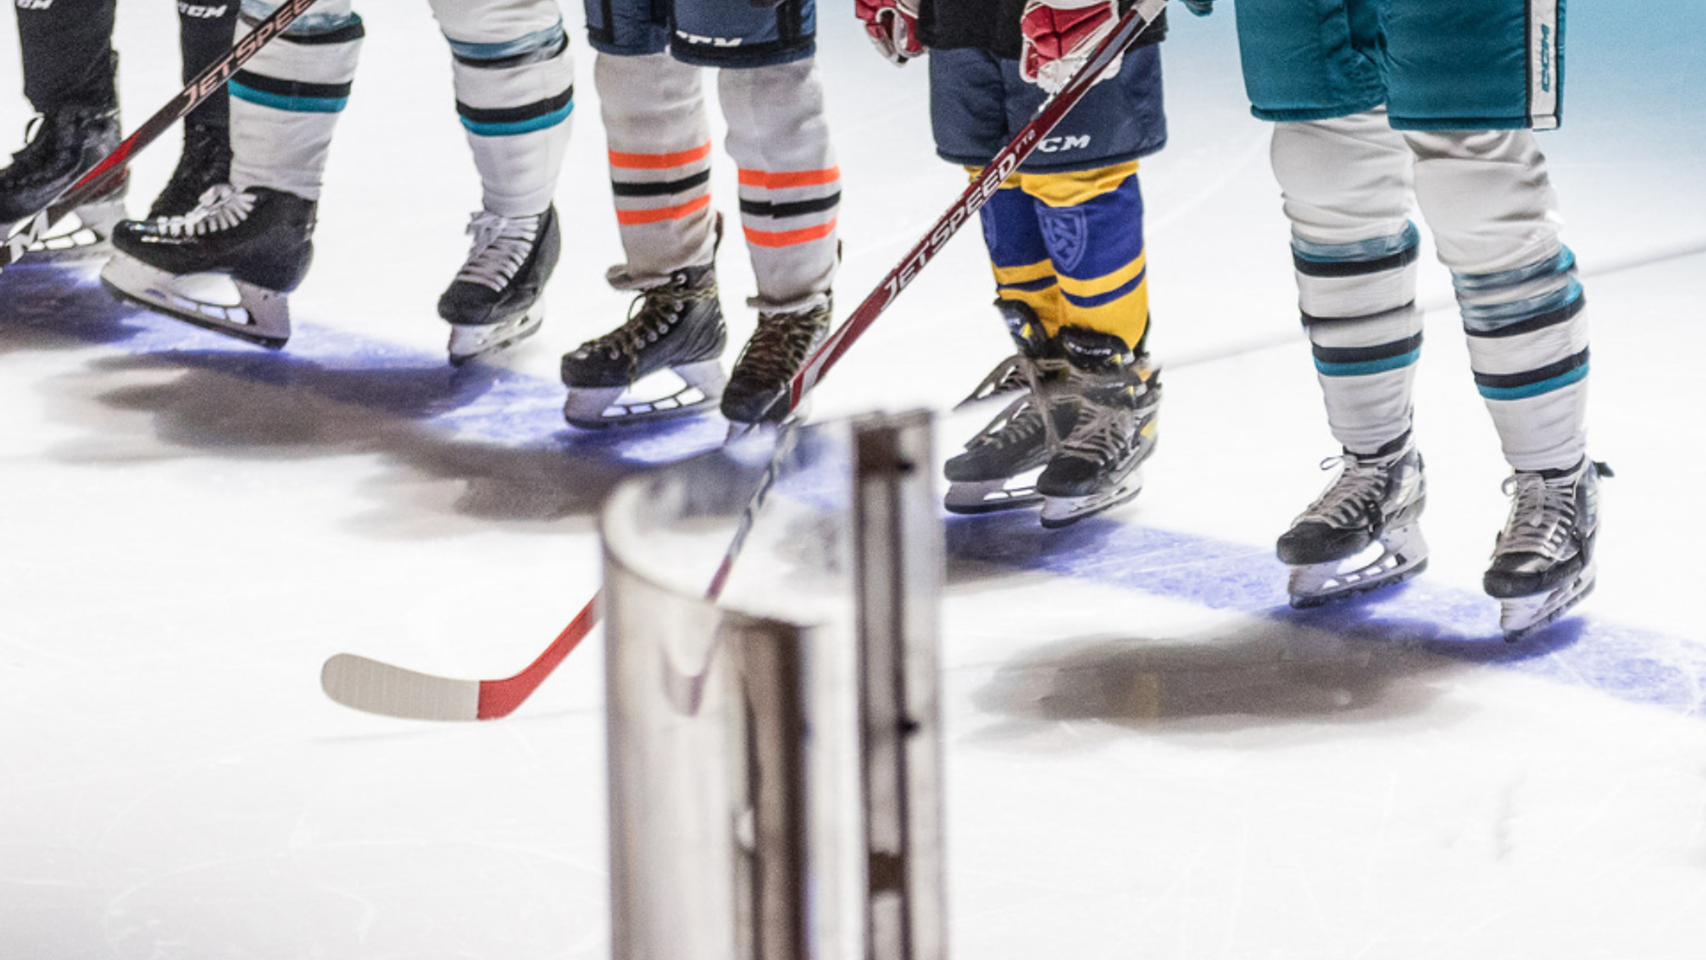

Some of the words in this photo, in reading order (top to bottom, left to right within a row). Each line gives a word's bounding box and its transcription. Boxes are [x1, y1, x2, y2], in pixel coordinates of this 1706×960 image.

[1541, 23, 1550, 93] CCM
[1037, 135, 1091, 152] CM
[881, 152, 1016, 311] JETSPEED
